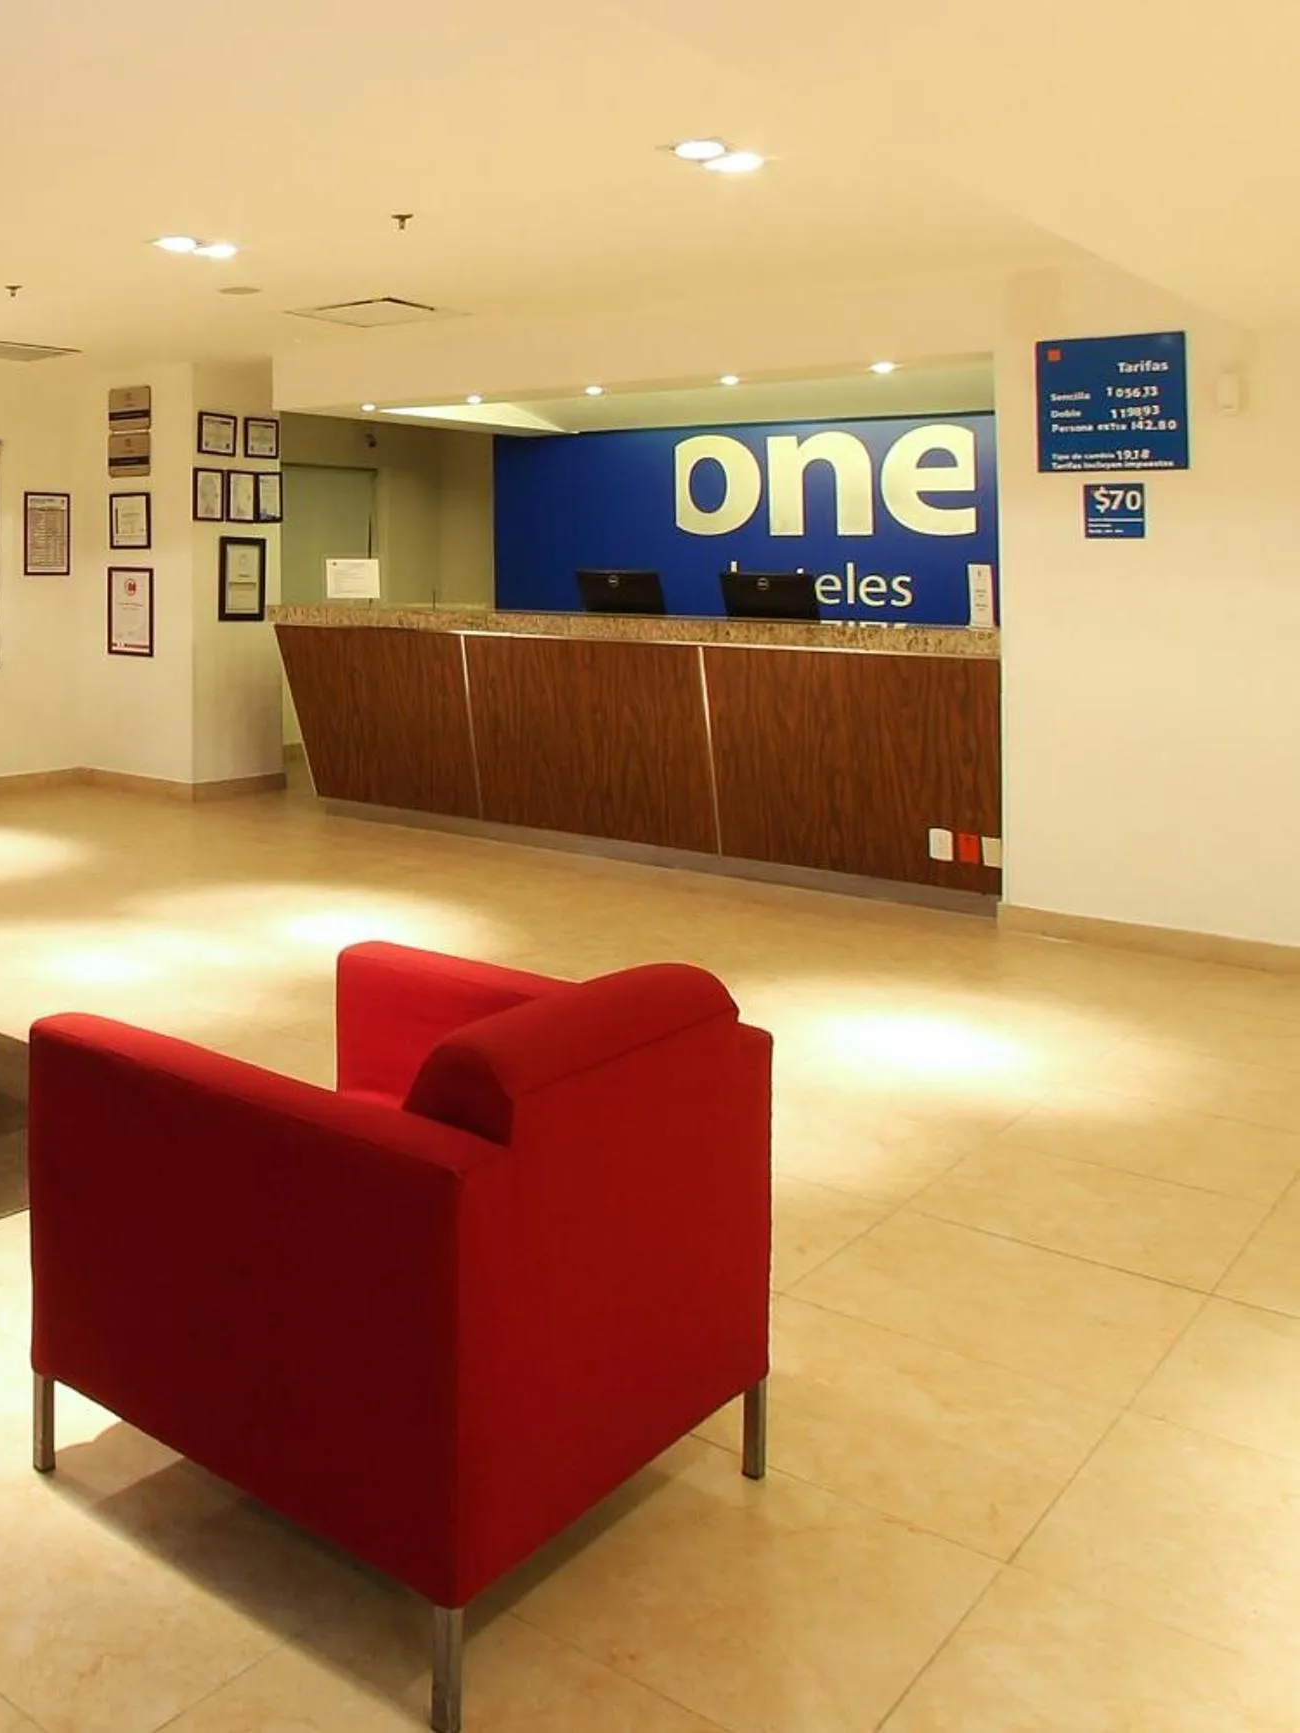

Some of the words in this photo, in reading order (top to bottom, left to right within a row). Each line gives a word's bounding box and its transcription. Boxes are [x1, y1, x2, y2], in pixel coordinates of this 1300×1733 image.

[1117, 360, 1169, 373] Tarifas
[1050, 409, 1082, 419] Doble
[1051, 422, 1094, 433] Persona
[1096, 422, 1128, 432] extra
[675, 424, 977, 536] one
[1094, 486, 1141, 514] $70
